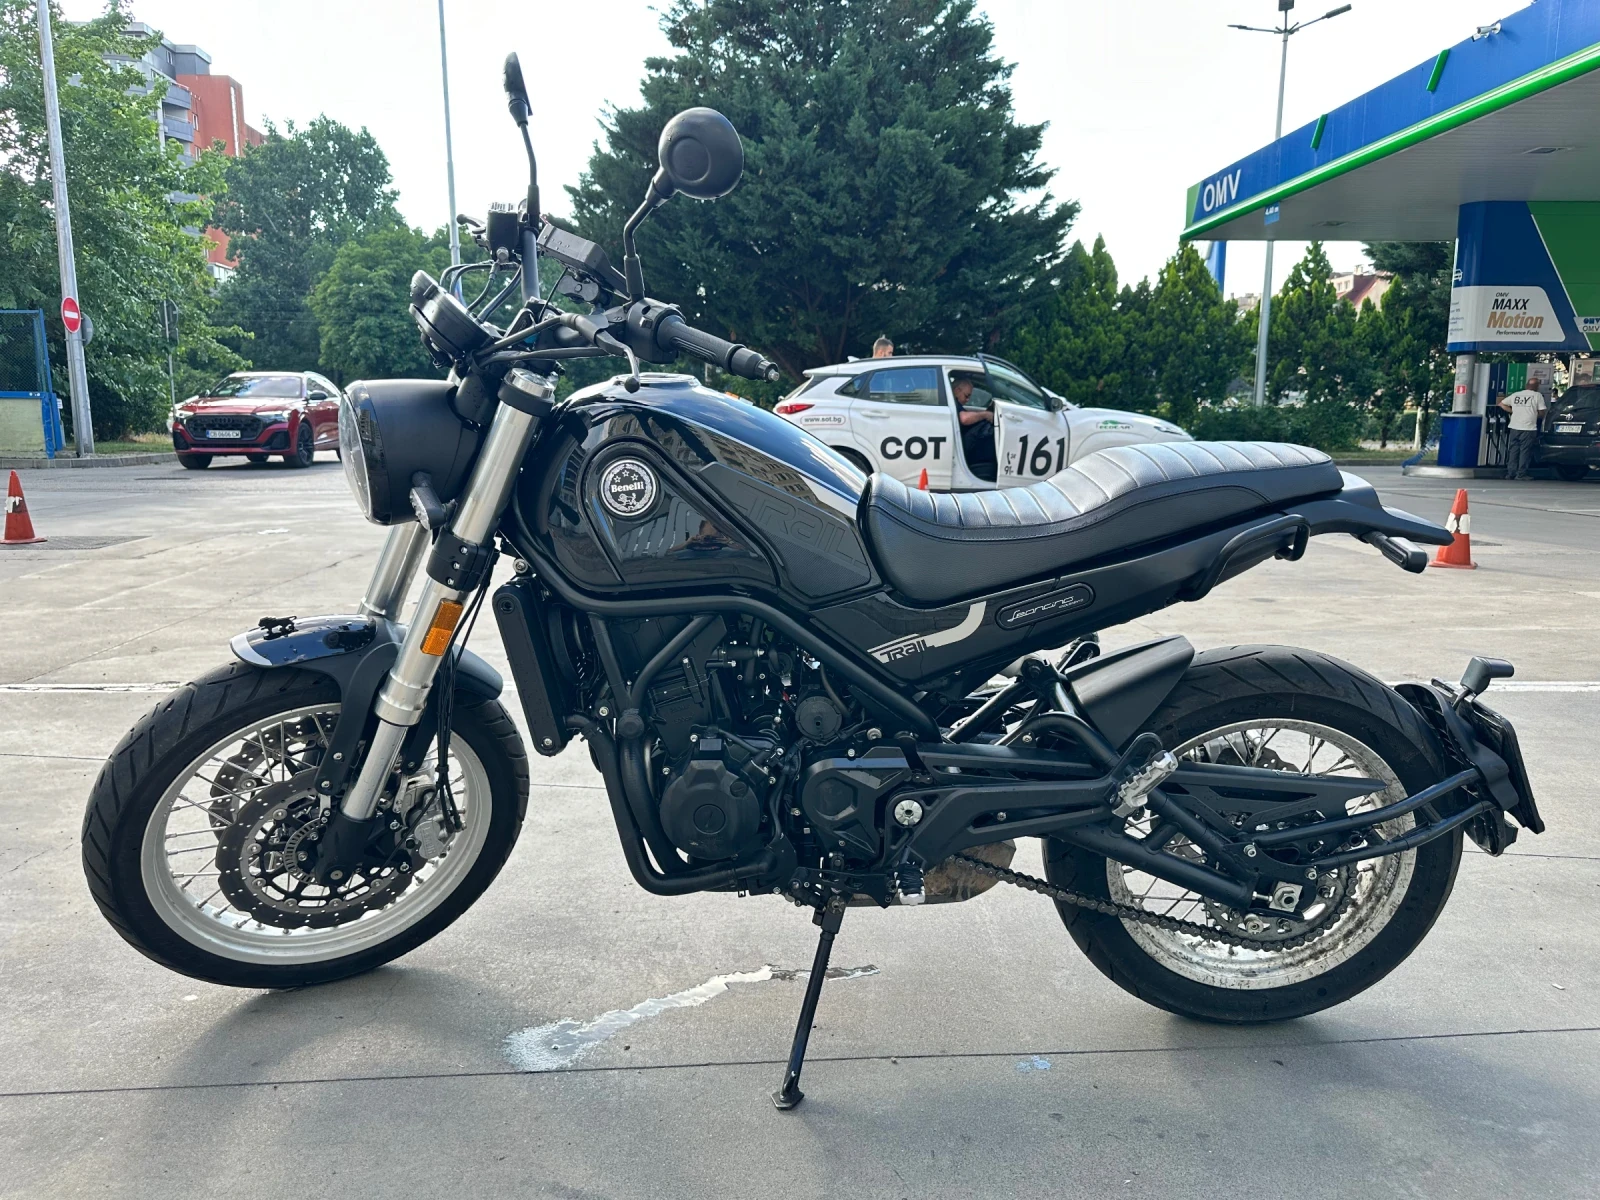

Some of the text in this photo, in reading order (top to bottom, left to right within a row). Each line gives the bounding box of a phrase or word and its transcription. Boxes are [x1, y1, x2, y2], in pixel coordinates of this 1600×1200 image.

[1203, 168, 1242, 212] OMV
[1491, 298, 1530, 311] MAXX
[1486, 311, 1544, 328] Motion
[1017, 433, 1066, 477] 161
[611, 481, 645, 493] Benelli
